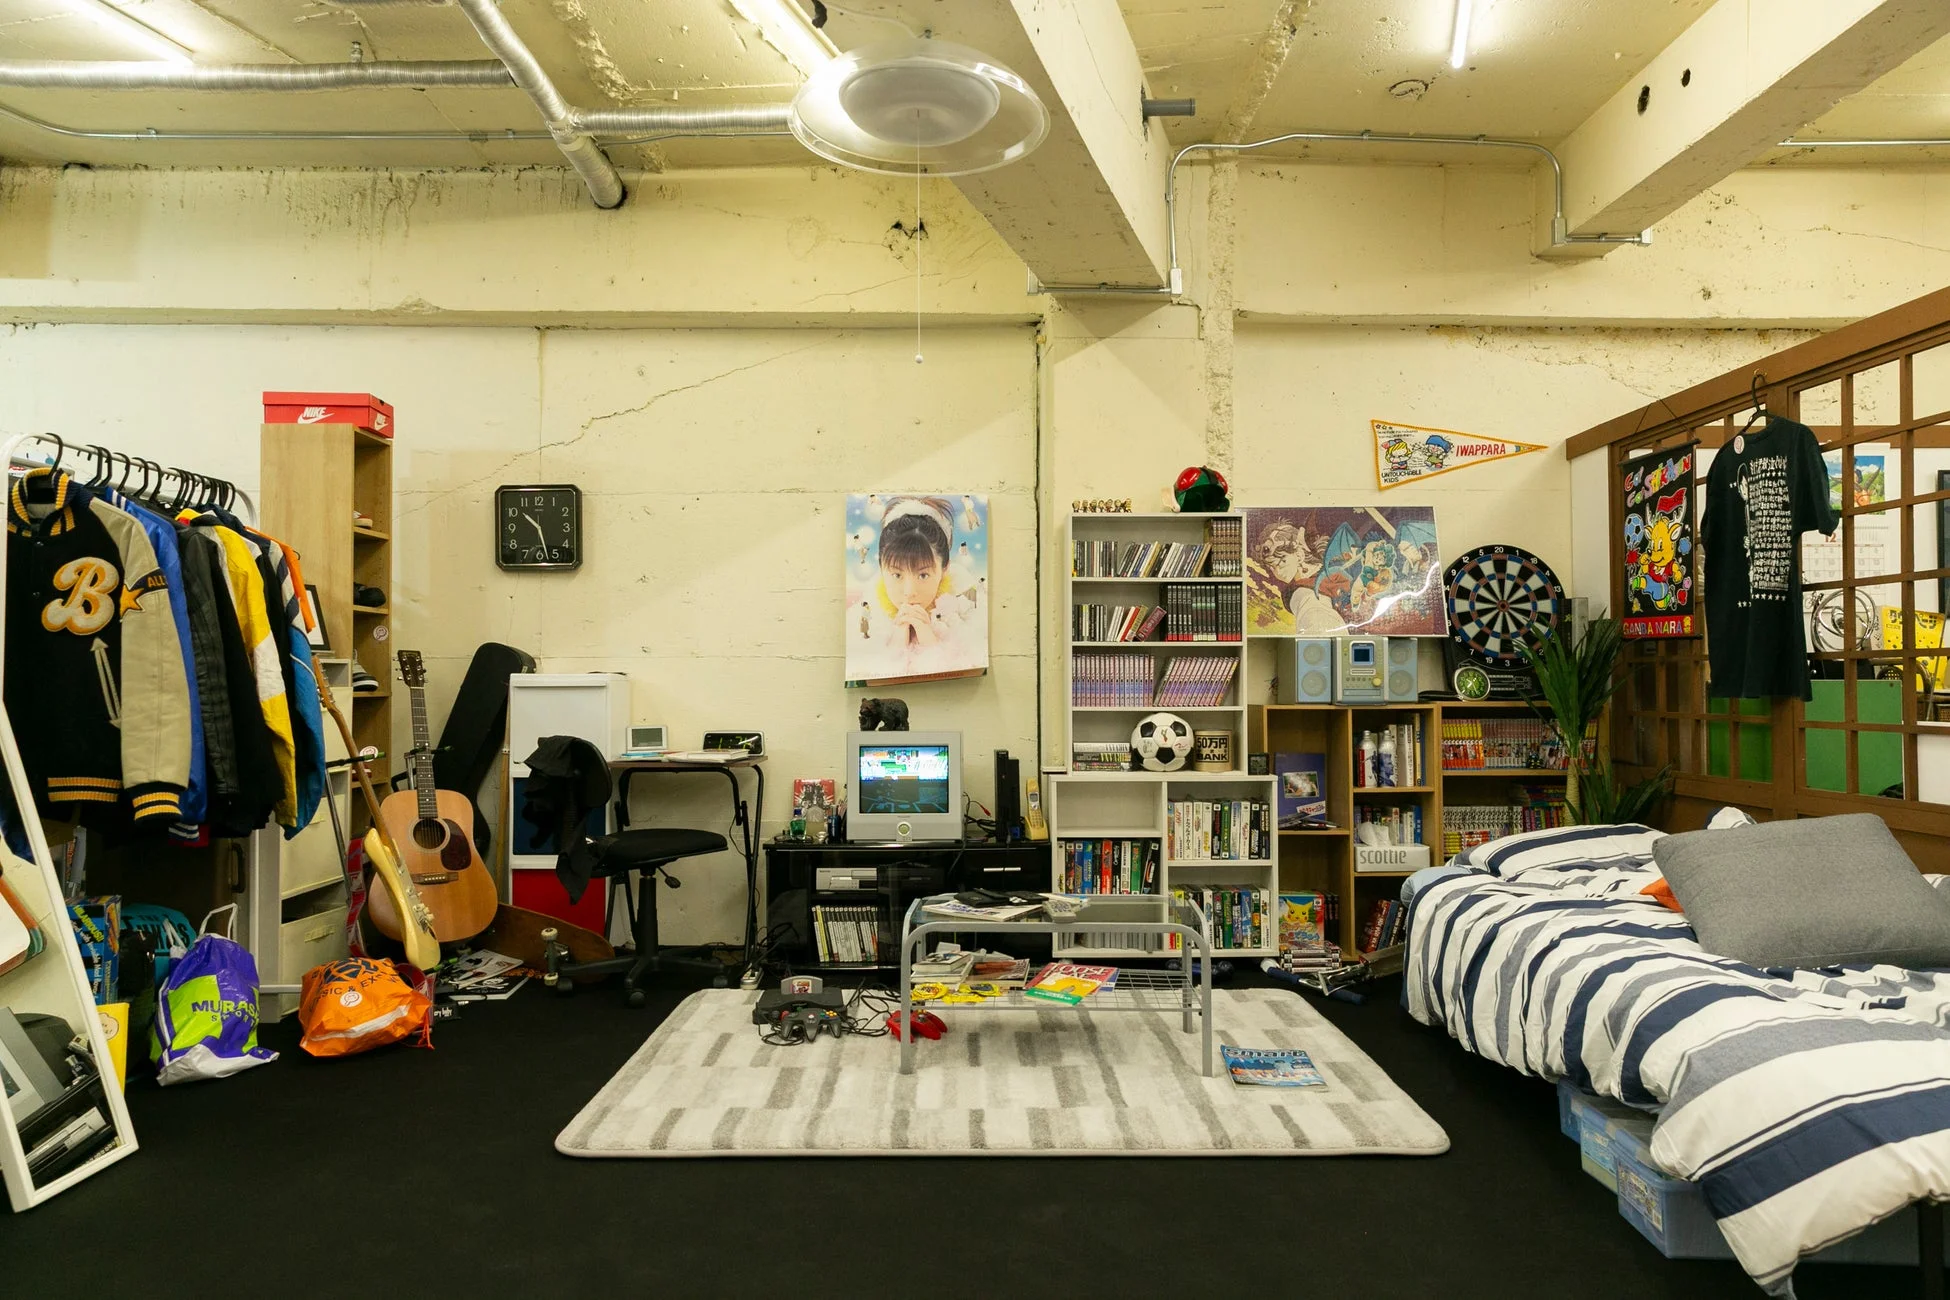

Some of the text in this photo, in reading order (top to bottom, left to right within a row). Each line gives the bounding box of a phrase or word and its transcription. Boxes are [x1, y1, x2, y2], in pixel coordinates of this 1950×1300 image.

[303, 407, 326, 418] NIKE
[1455, 443, 1506, 457] IWAPPARA
[1381, 469, 1422, 479] UNTOUCHABLE
[521, 497, 528, 507] 11
[534, 496, 544, 506] 12
[552, 497, 556, 507] 1
[508, 507, 518, 517] 10
[562, 507, 569, 517] 2
[508, 523, 516, 533] 9
[562, 522, 571, 533] 3
[509, 539, 518, 550] 8
[562, 539, 569, 548] 4
[521, 549, 529, 559] 7
[535, 550, 544, 560] 6
[551, 549, 560, 559] 5
[1494, 546, 1504, 554] 20
[41, 557, 119, 635] B
[1623, 621, 1683, 636] GANBA NARA
[1538, 648, 1544, 656] 2
[1197, 737, 1228, 749] 50万円
[1359, 849, 1407, 864] scottie
